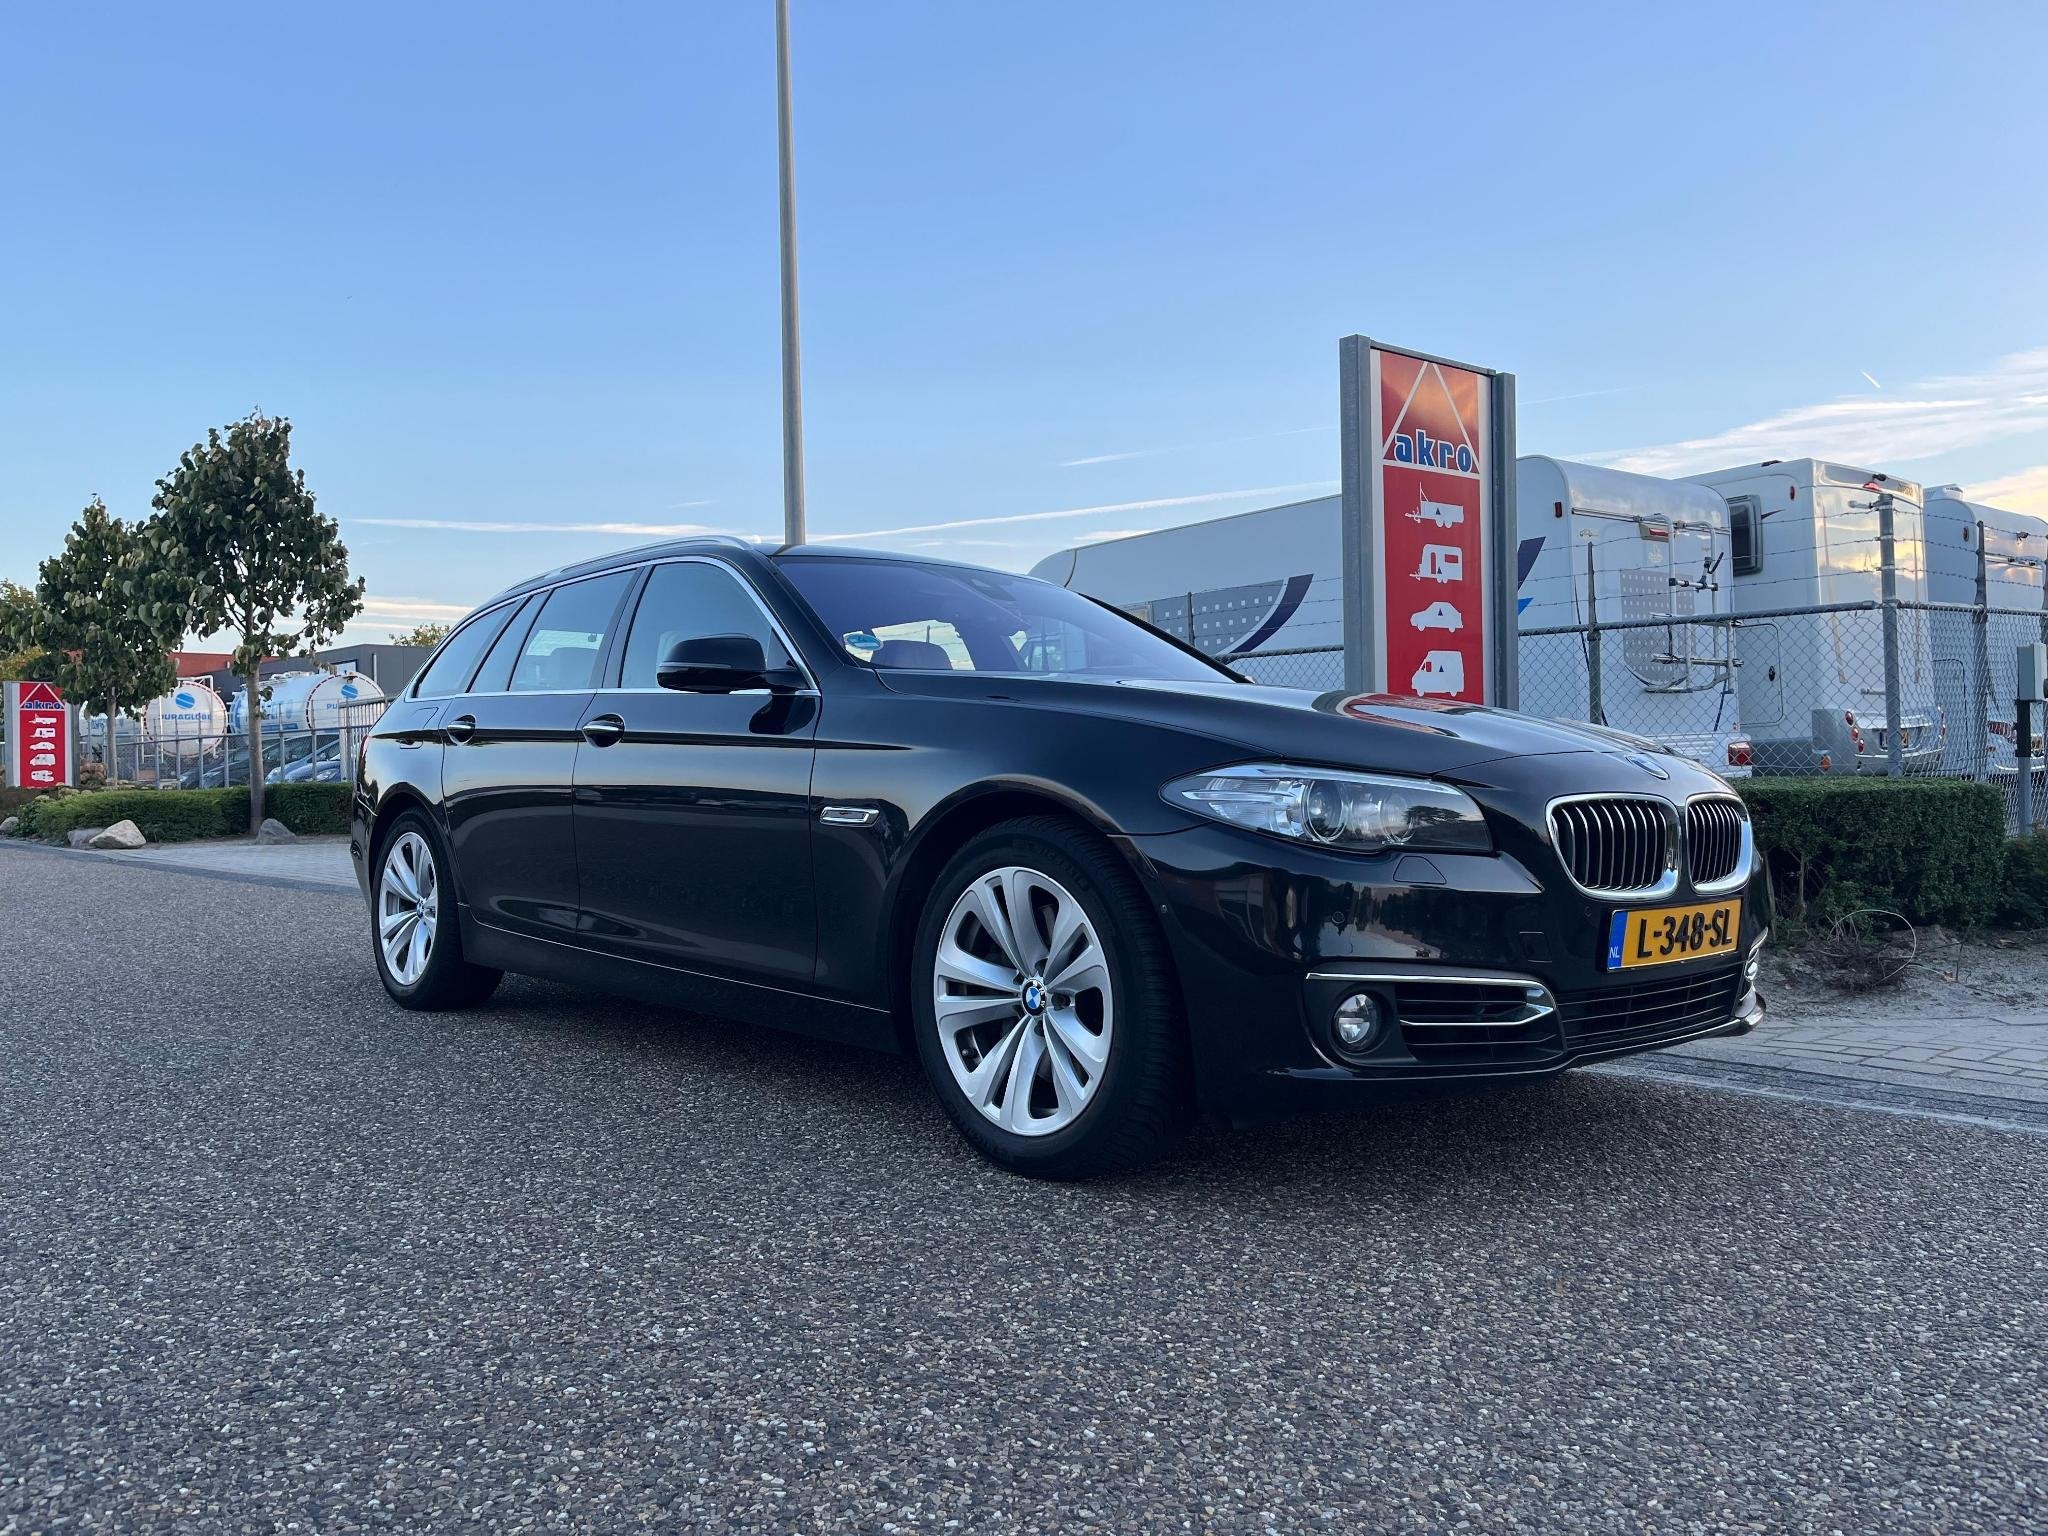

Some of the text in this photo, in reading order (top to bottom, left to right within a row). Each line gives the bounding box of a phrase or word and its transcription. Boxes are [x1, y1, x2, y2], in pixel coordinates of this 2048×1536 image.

[1394, 429, 1473, 473] akro
[24, 700, 61, 710] akro
[1637, 908, 1732, 958] L-348-SL
[1609, 946, 1620, 958] NL
